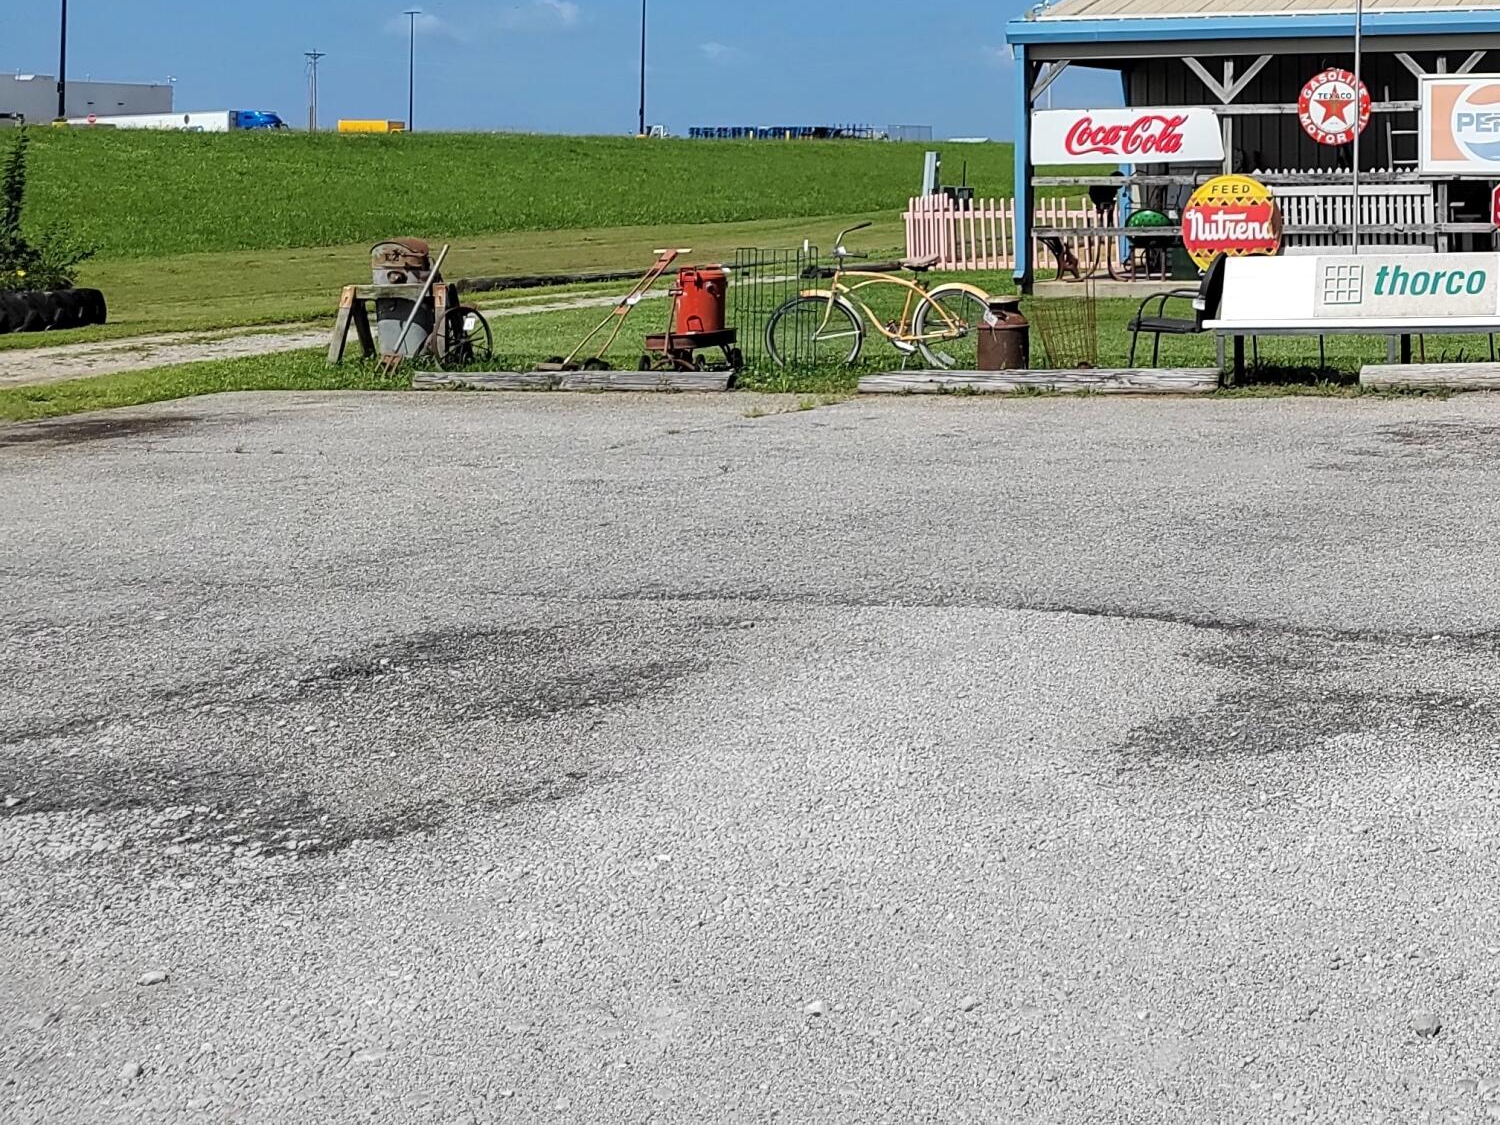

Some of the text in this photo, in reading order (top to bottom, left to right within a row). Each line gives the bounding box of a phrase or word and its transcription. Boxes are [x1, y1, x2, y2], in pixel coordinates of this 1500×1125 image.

[1317, 92, 1352, 100] TEXACO
[1065, 114, 1189, 156] Coca-Cola
[1300, 113, 1348, 144] MOTOR
[1211, 184, 1251, 195] FEED
[1374, 264, 1487, 296] thorco
